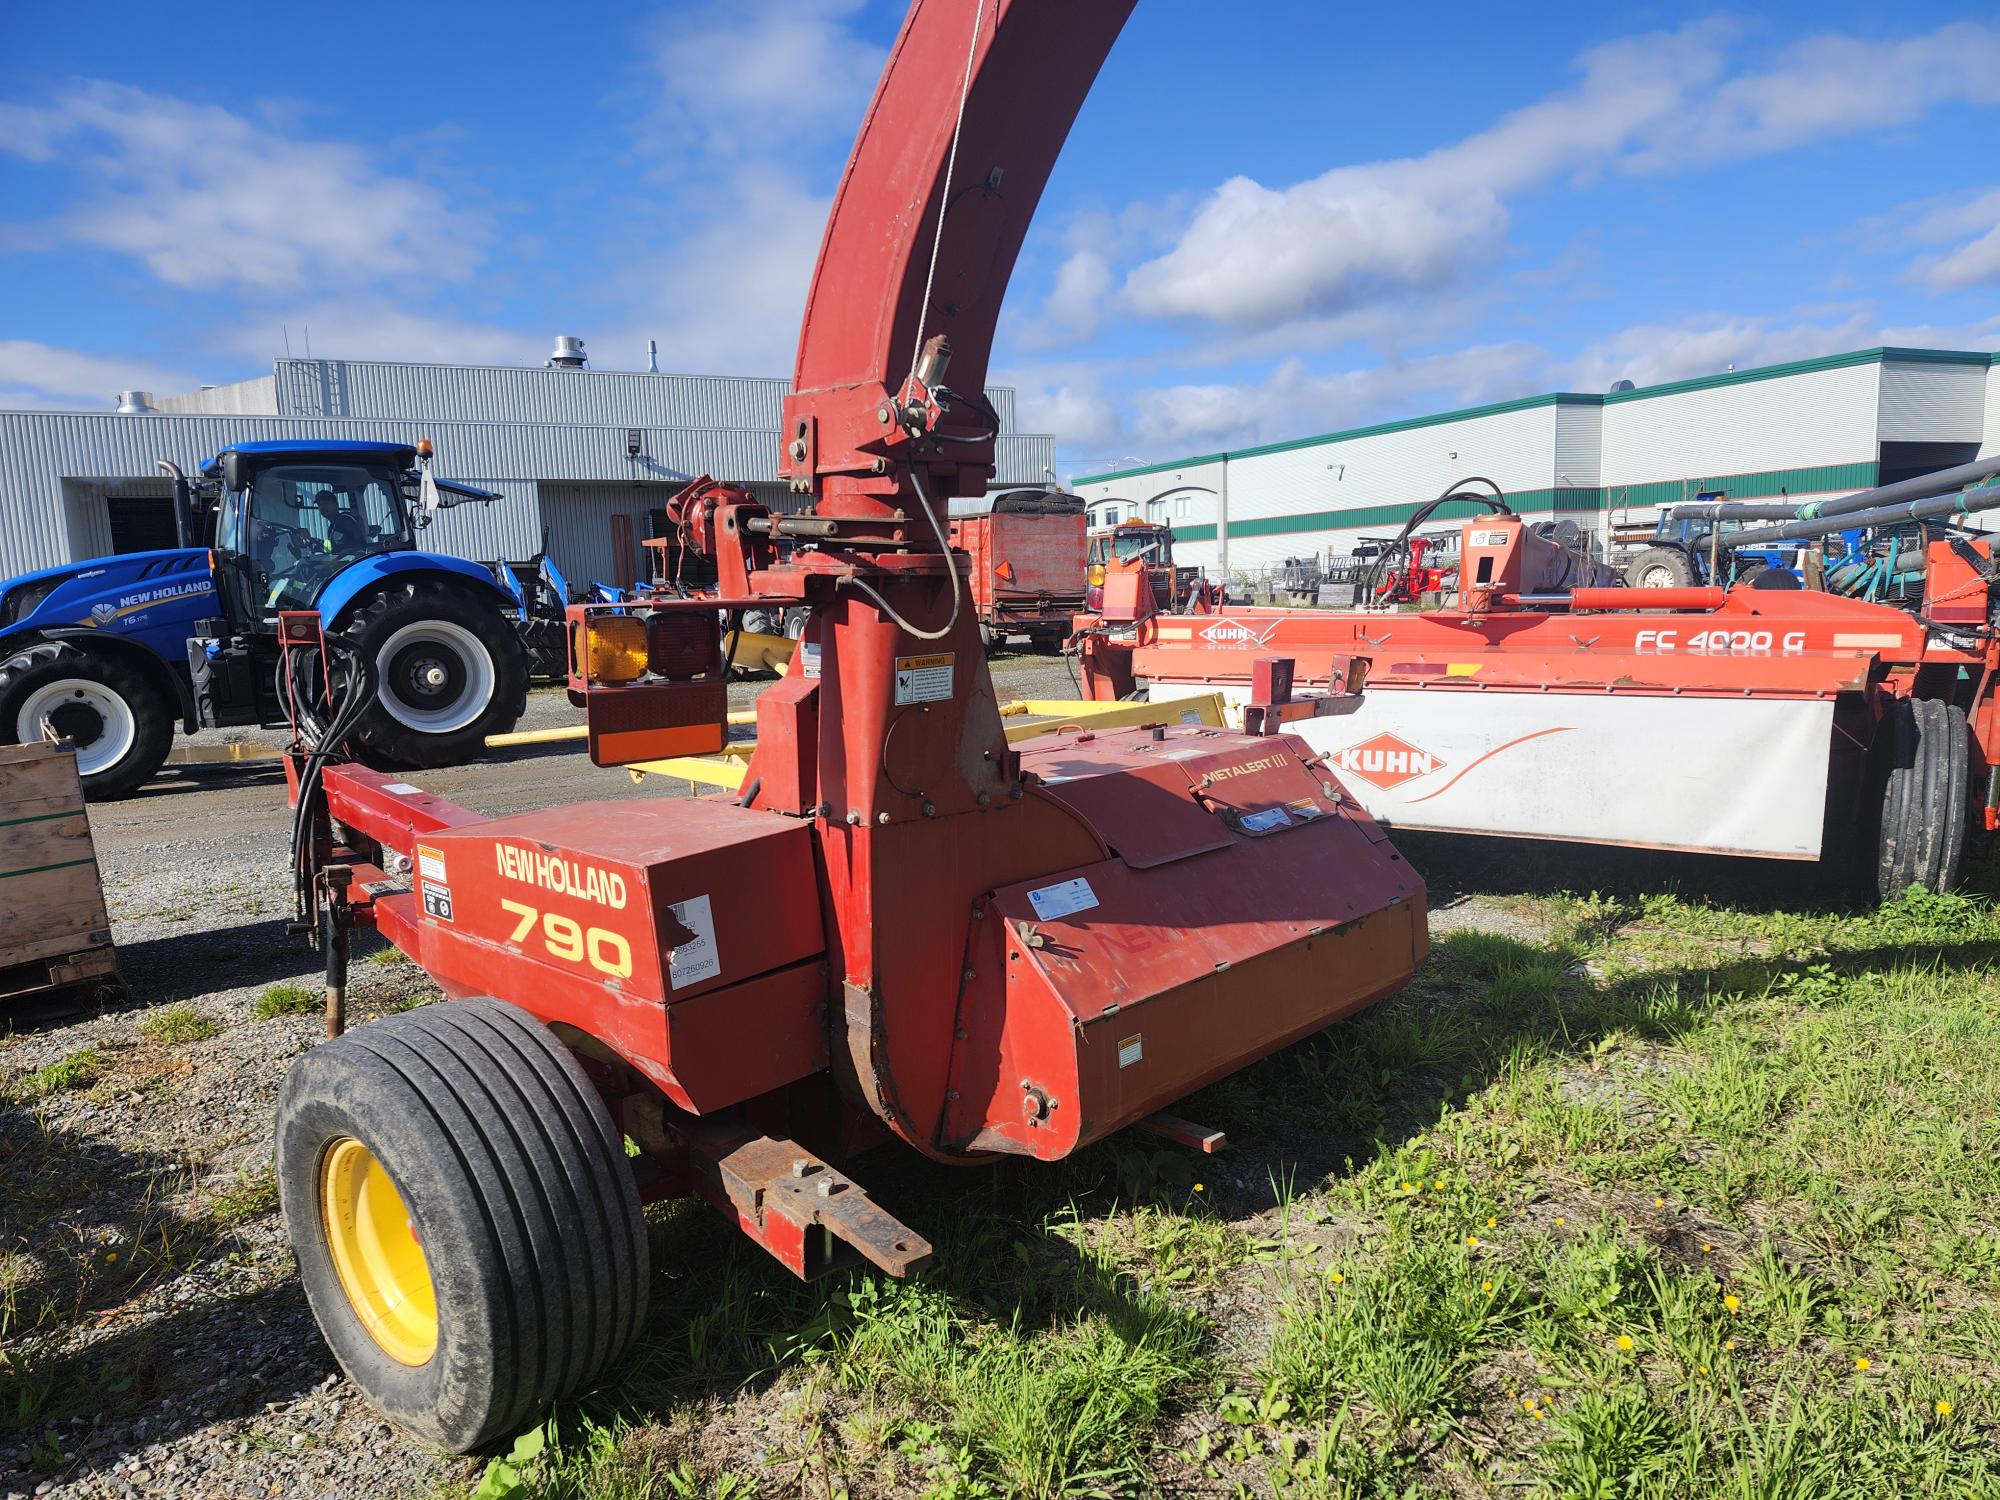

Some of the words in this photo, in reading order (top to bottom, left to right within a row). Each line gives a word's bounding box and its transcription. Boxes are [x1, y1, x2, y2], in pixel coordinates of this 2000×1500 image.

[120, 592, 151, 608] NEW
[153, 581, 212, 600] HOLLAND
[1207, 628, 1248, 640] KUHN
[1635, 630, 1677, 649] FC
[1687, 631, 1773, 650] 4000
[1782, 631, 1806, 650] G
[914, 656, 945, 667] WARNING
[1202, 758, 1272, 782] METALERT
[1341, 749, 1432, 775] KUHN
[495, 842, 534, 884] NEW
[535, 852, 627, 909] HOLLAND
[500, 898, 633, 979] 790
